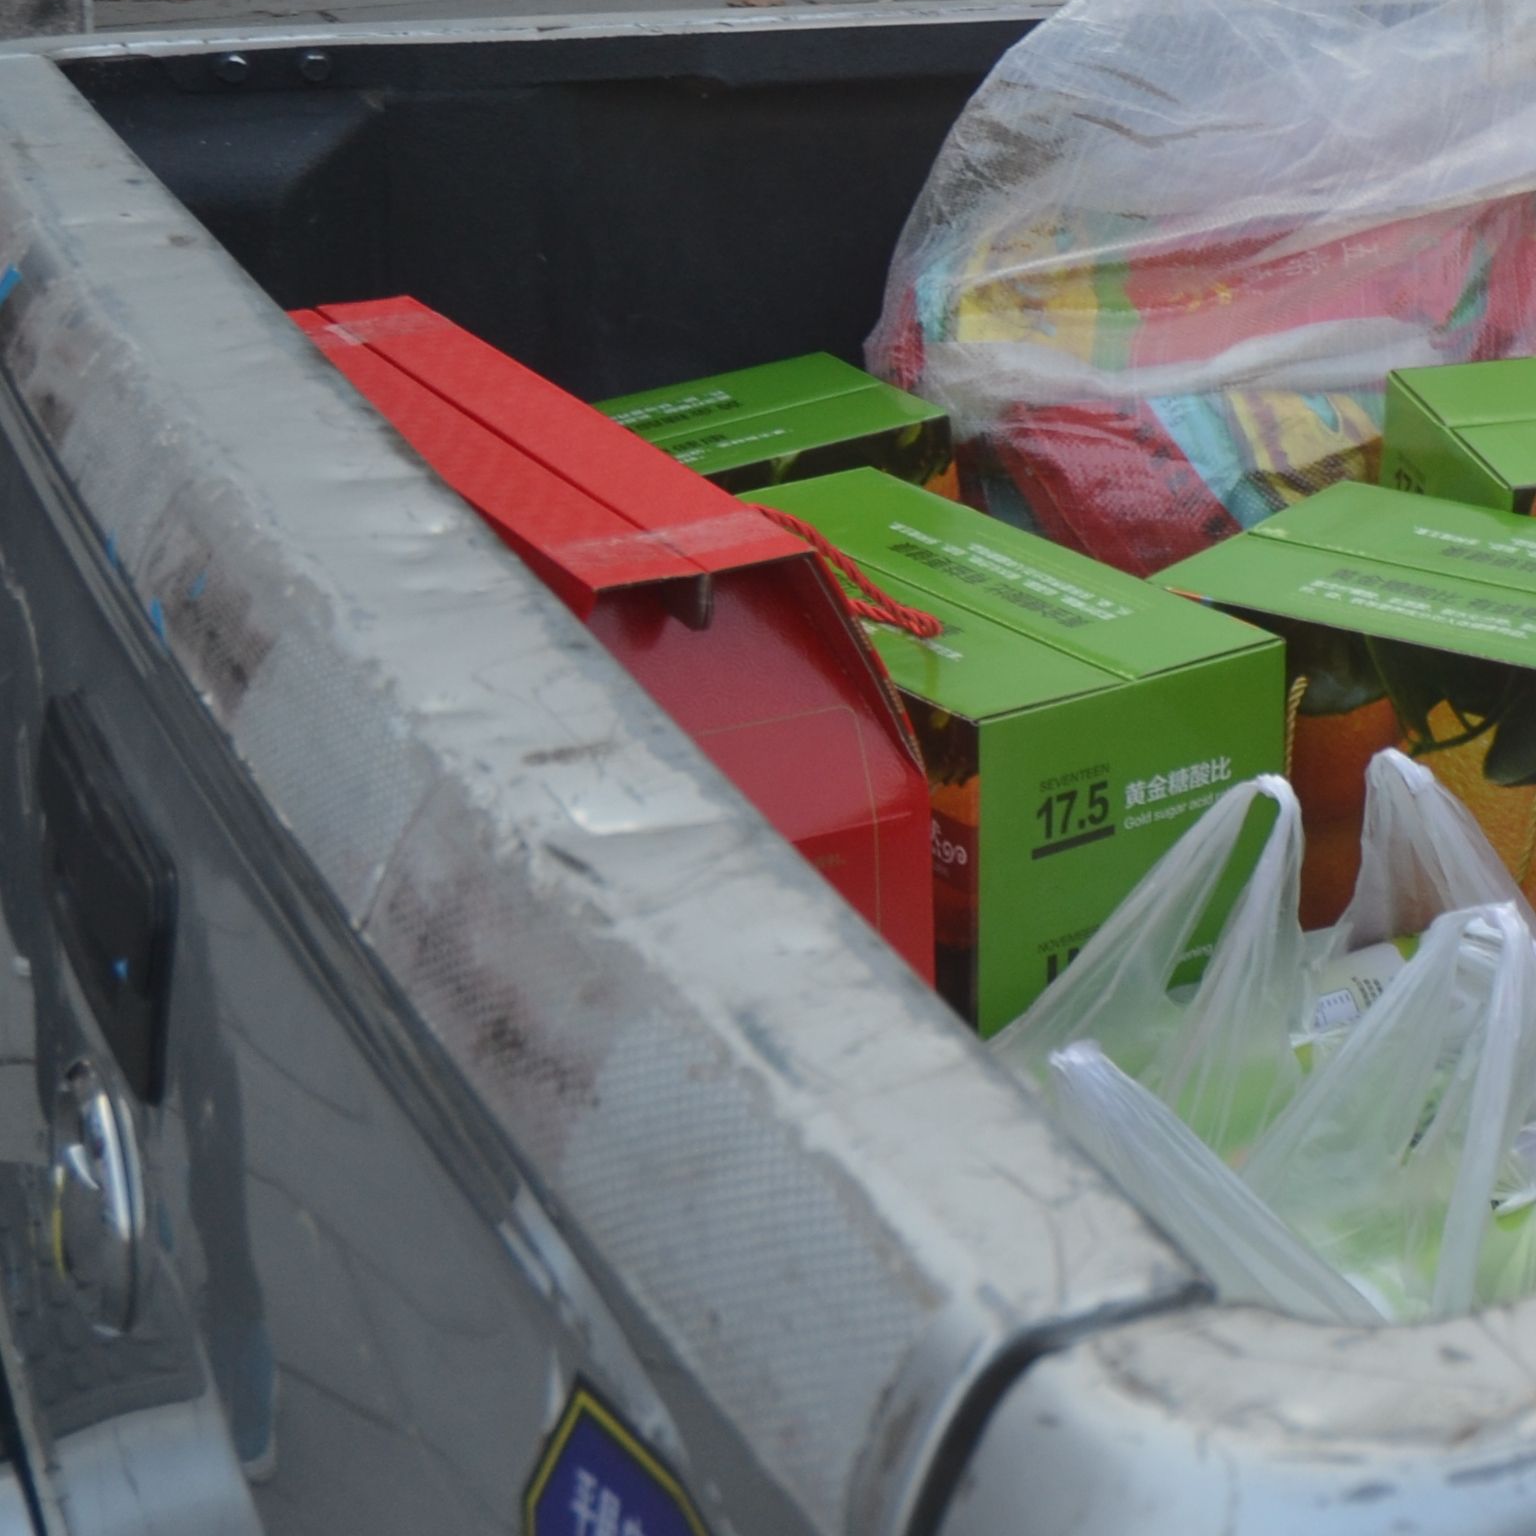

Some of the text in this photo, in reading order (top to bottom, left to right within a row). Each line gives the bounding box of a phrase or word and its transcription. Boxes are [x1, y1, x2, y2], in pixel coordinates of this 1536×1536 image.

[1036, 780, 1110, 839] 17.5
[1124, 756, 1232, 810] 黄金糖酸比
[1124, 811, 1151, 830] Gold
[1152, 801, 1187, 821] sugar
